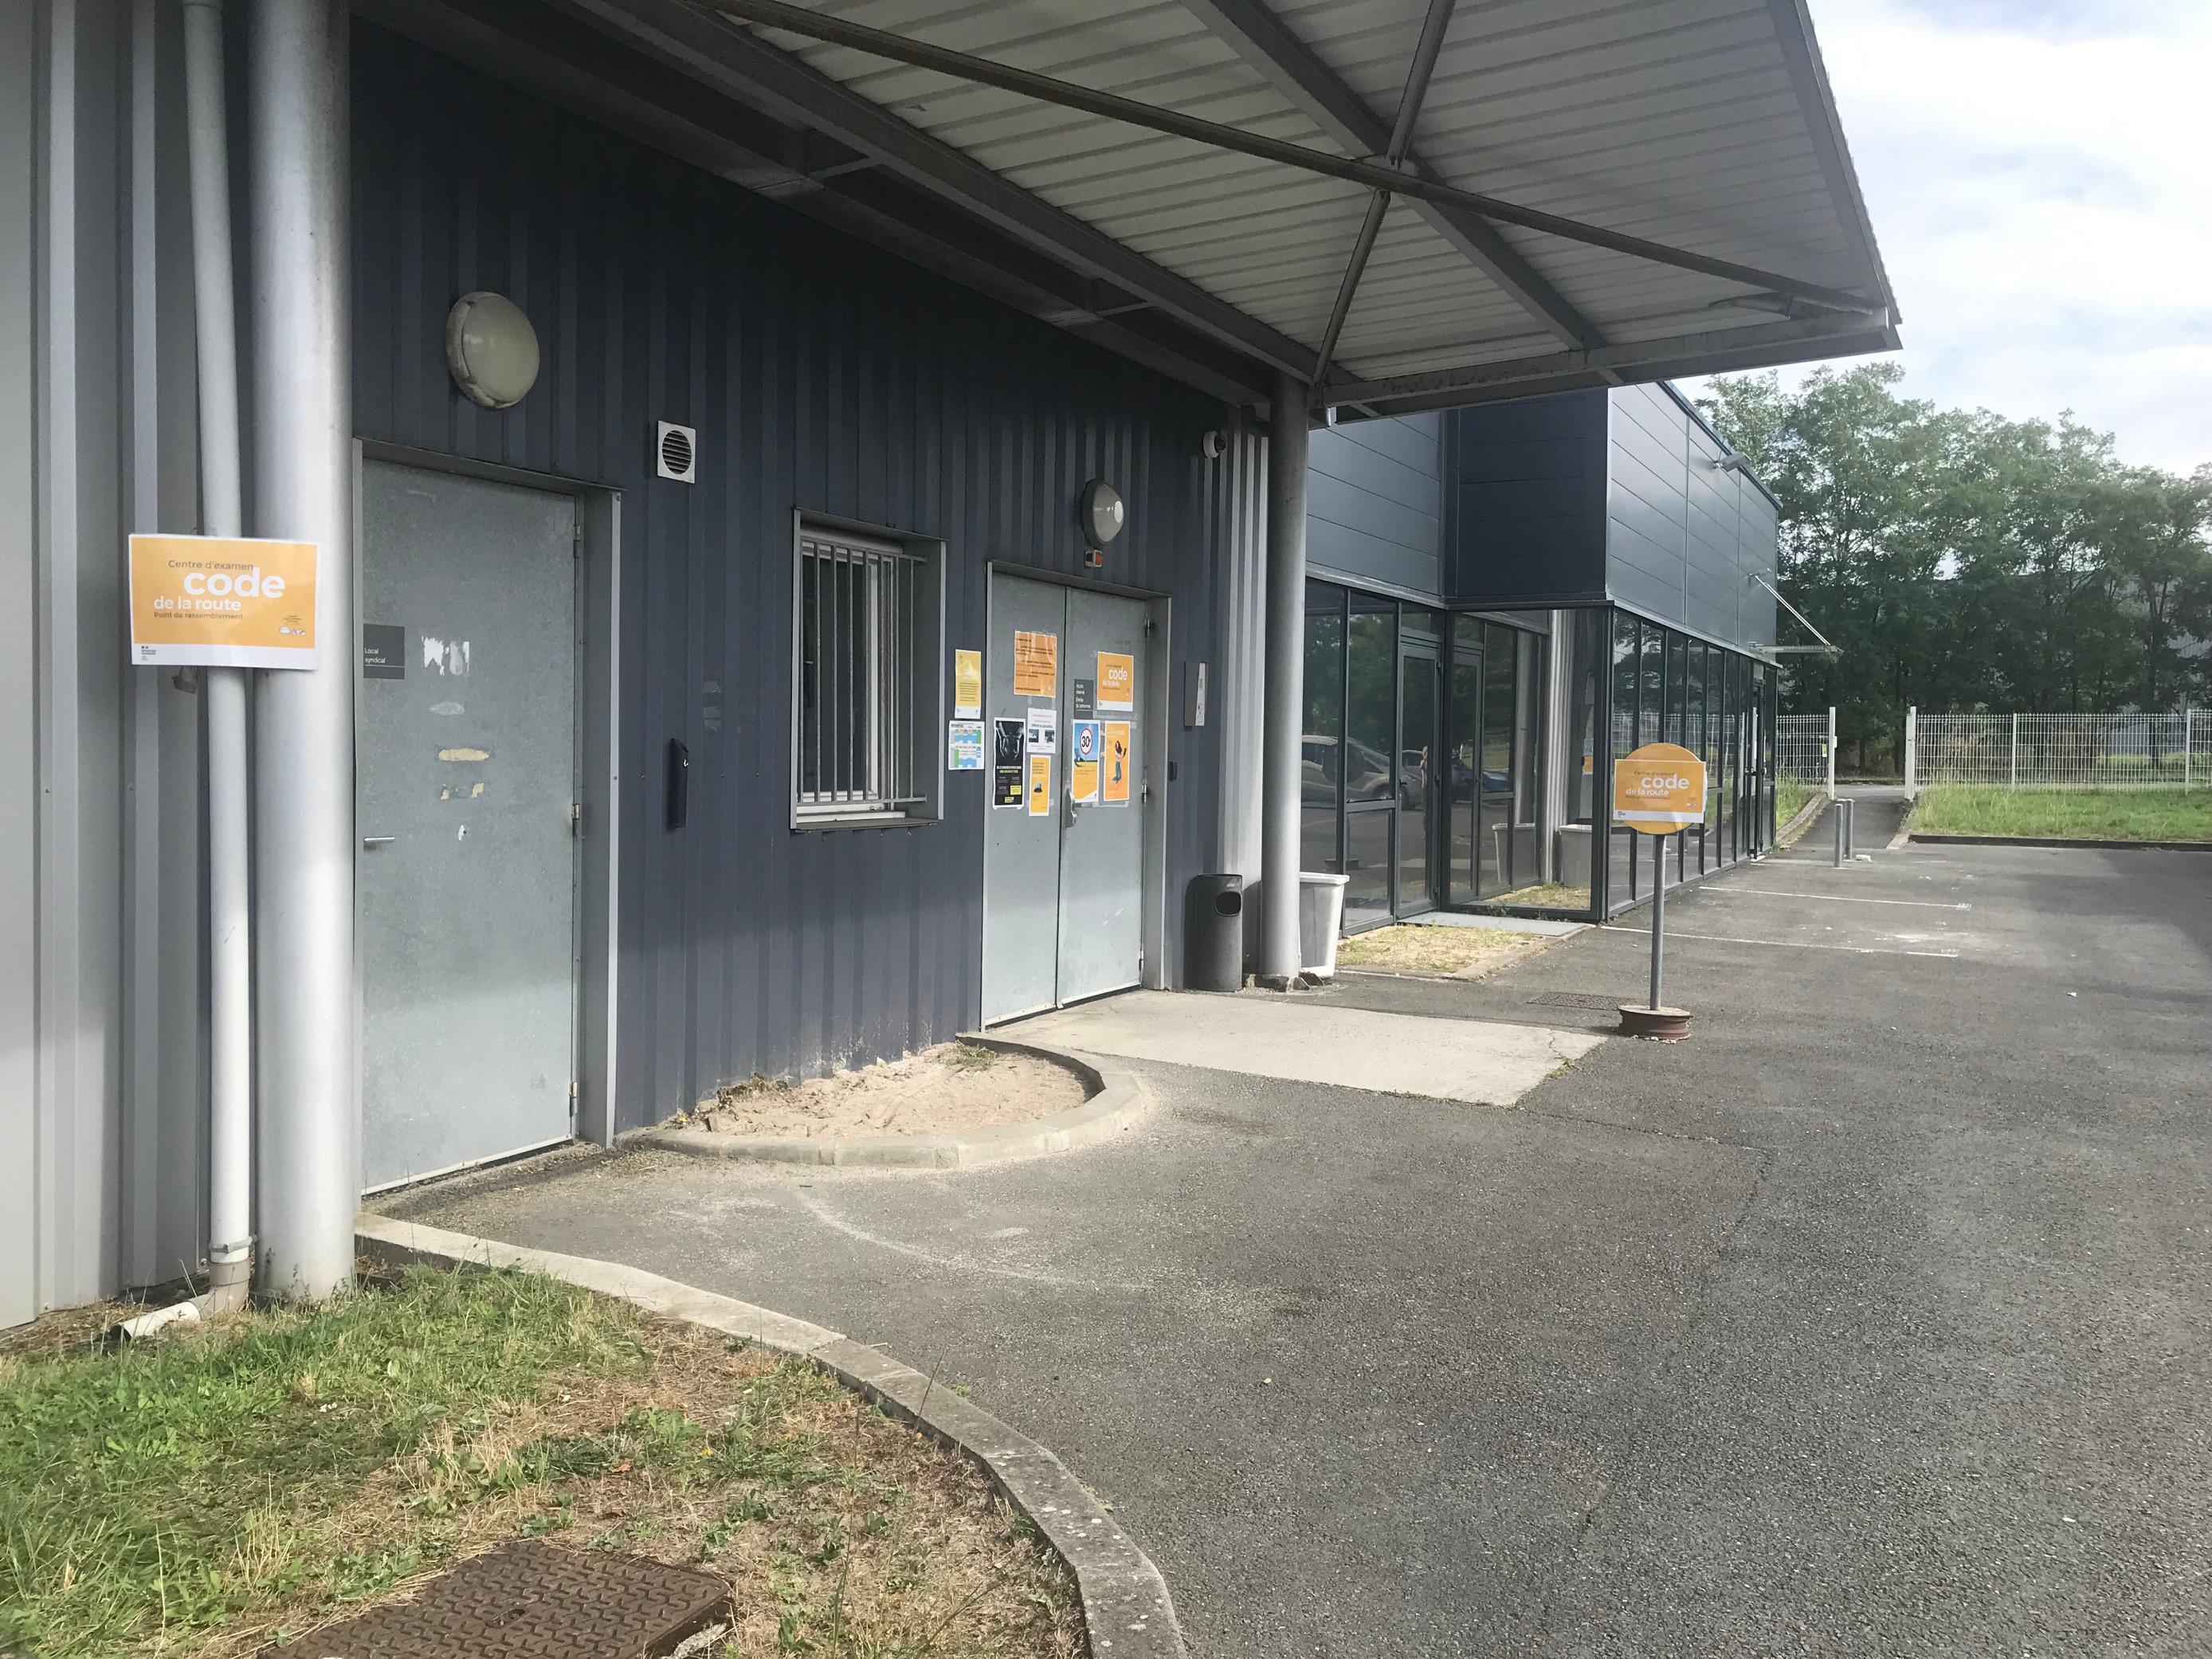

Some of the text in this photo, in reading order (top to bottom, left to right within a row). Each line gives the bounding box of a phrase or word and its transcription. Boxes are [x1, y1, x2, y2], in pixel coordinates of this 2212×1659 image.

[168, 559, 254, 571] Centre d'examen
[183, 566, 285, 598] code
[153, 595, 241, 611] de la route
[1108, 666, 1128, 681] code
[1641, 774, 1690, 790] code
